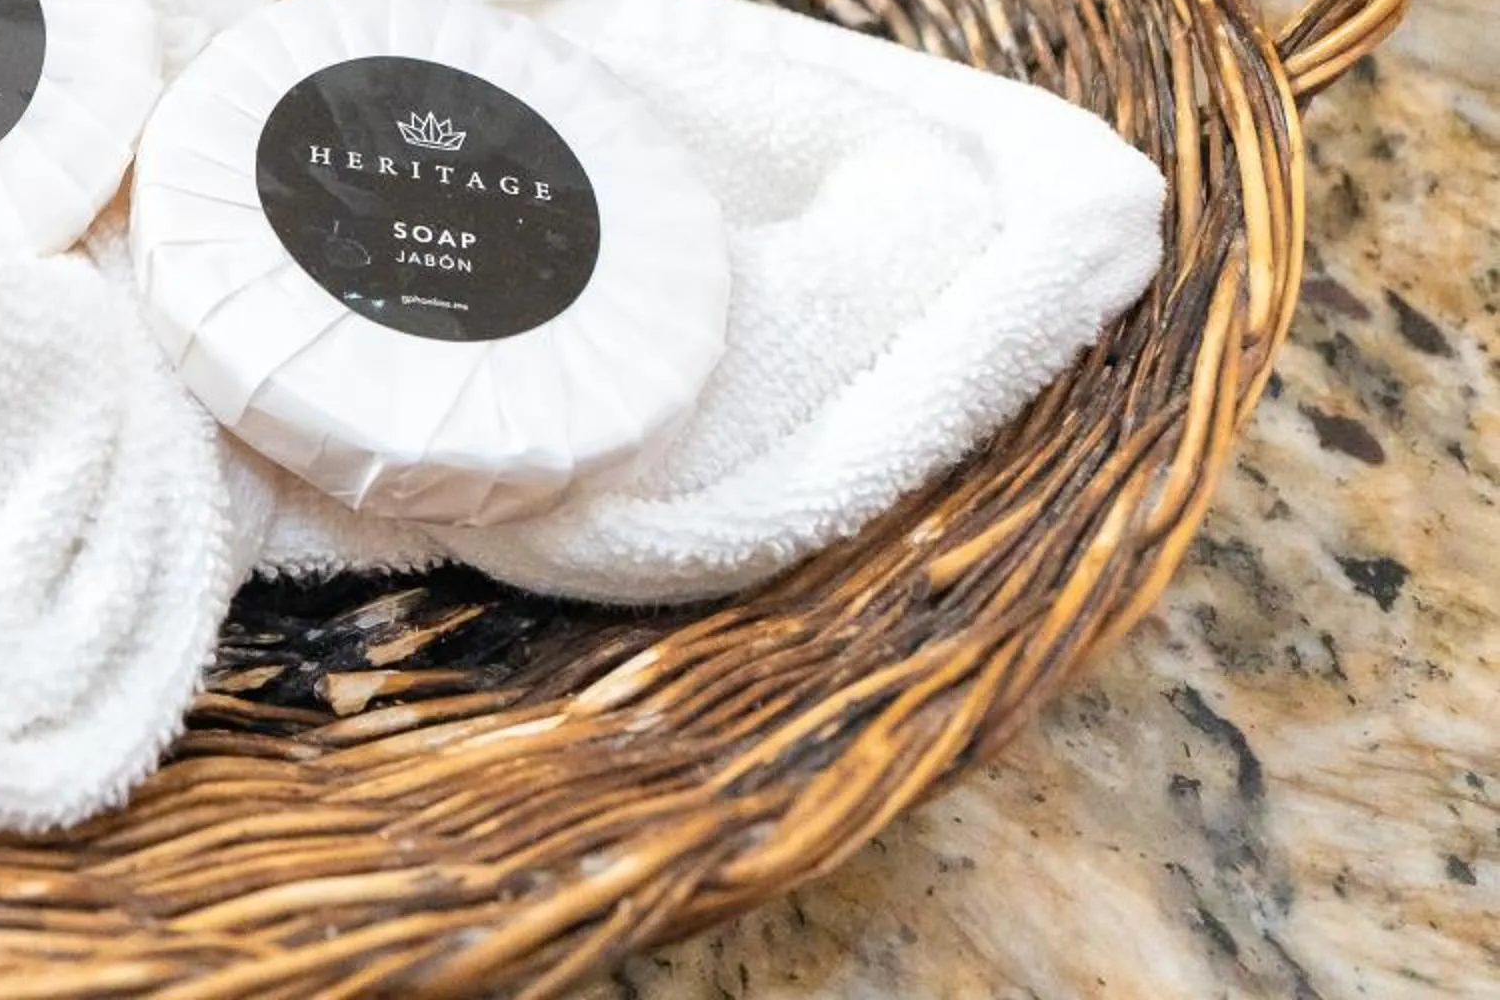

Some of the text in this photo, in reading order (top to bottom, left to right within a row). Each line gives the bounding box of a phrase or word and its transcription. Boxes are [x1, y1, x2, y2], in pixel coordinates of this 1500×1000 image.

[309, 145, 552, 201] HERITAGE
[393, 221, 477, 249] SOAP
[395, 250, 472, 273] JABÓN
